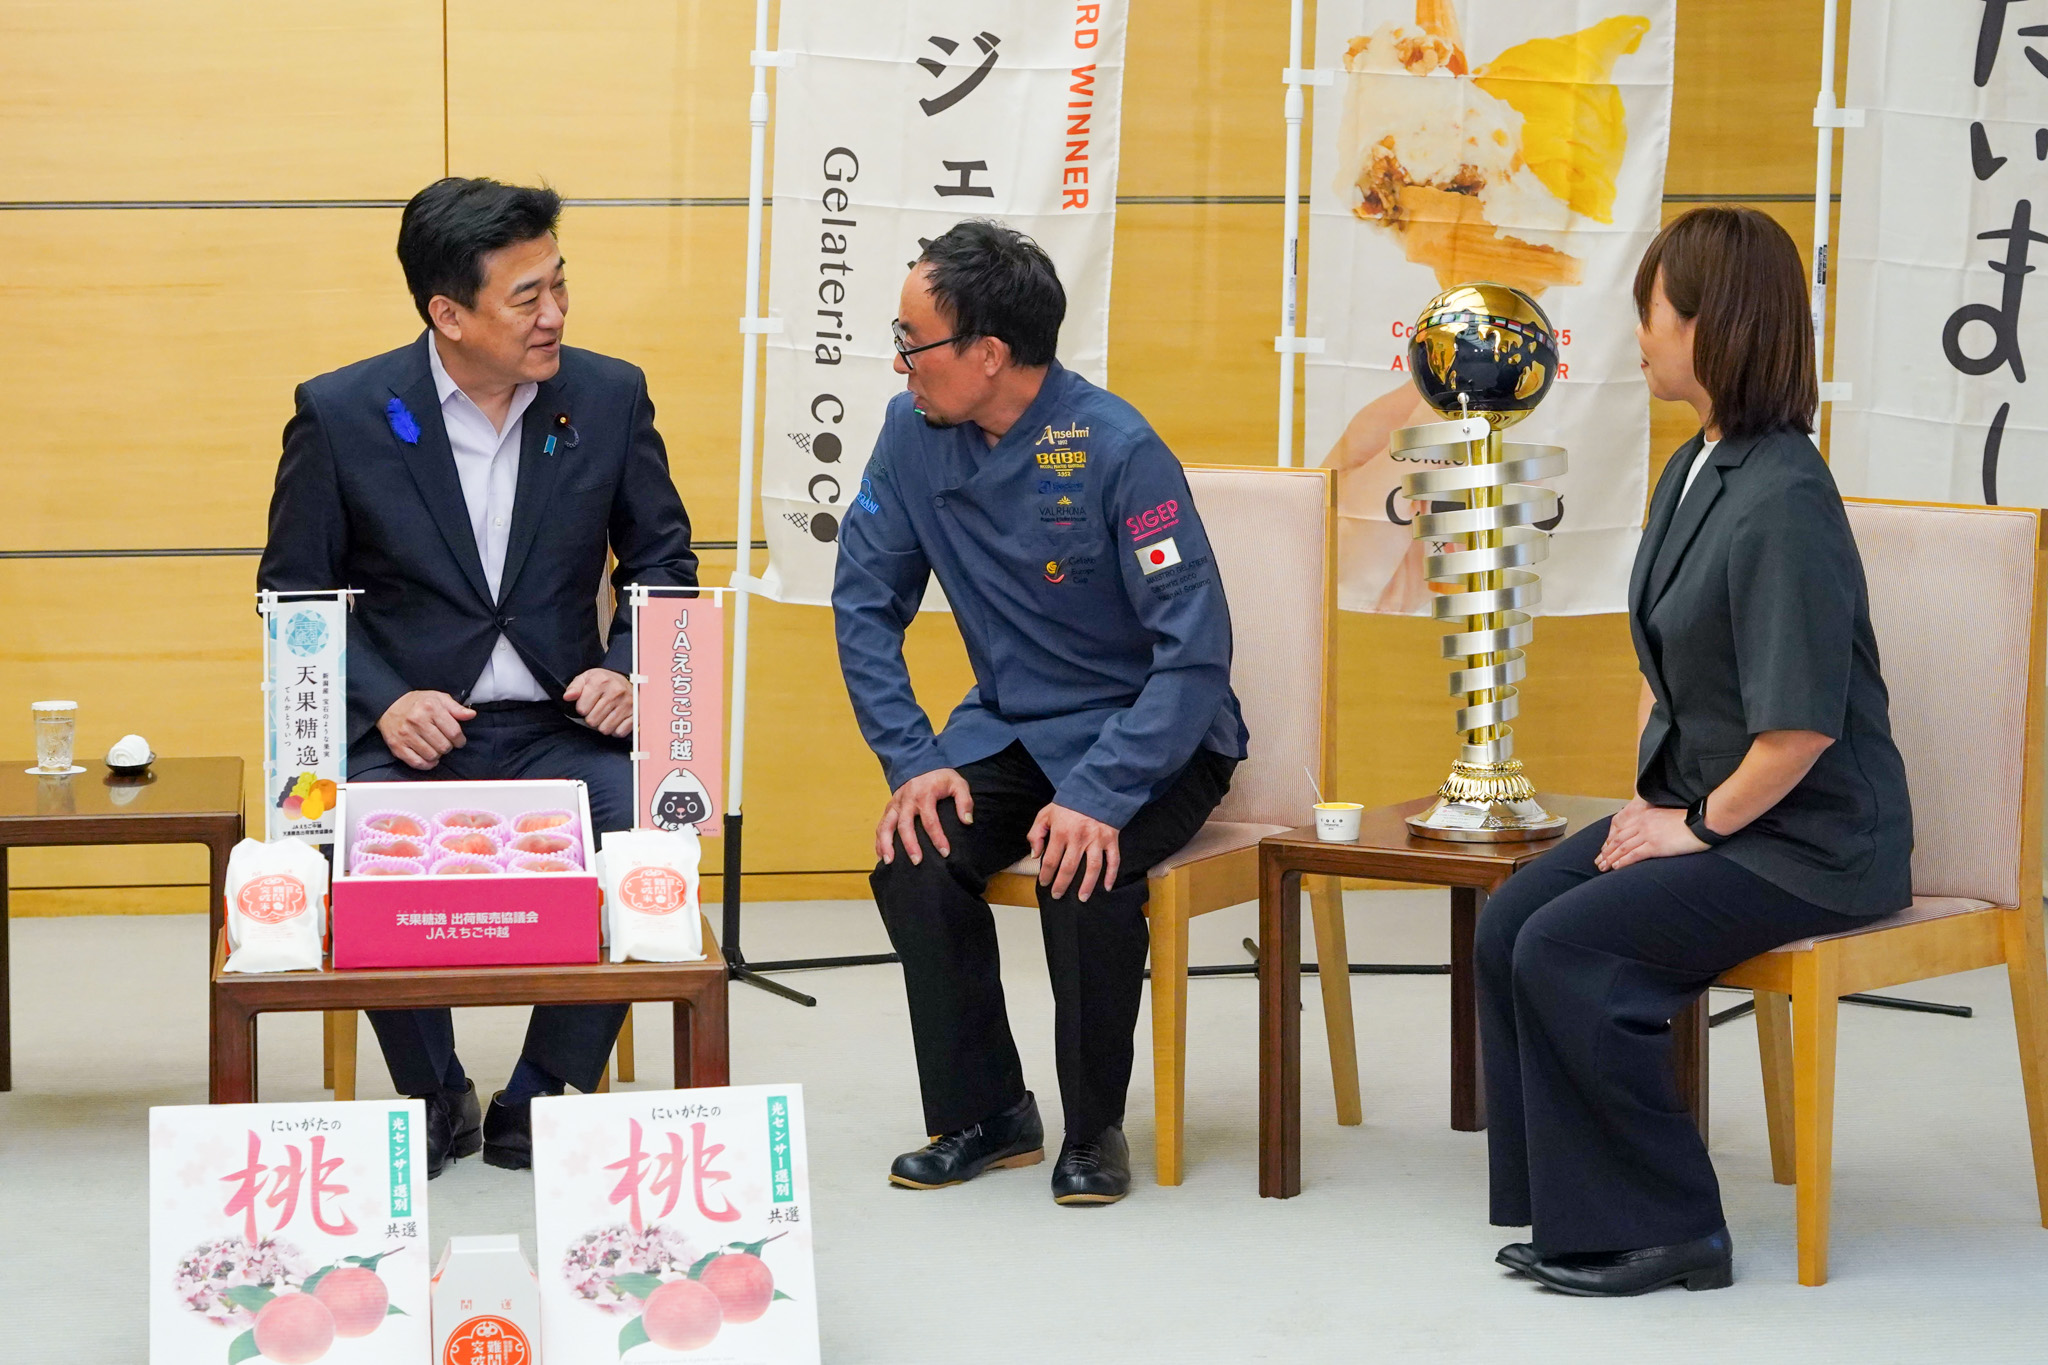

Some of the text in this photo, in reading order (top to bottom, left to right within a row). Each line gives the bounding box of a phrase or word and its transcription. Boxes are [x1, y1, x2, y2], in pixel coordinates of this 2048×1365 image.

[1062, 0, 1100, 210] RD WINNER
[815, 146, 860, 366] Gelateria
[1035, 422, 1090, 446] Anselmi
[1036, 451, 1087, 465] BABBI
[1039, 507, 1087, 516] VALRHONA
[1126, 500, 1178, 535] SIGEP
[670, 609, 693, 762] JAえちご中越
[294, 665, 319, 767] 天果糖逸
[396, 910, 539, 926] 天果糖逸 出荷販売協議会
[426, 926, 510, 940] JAえちご中越
[271, 1117, 341, 1132] にいがたの
[653, 1104, 721, 1120] にいがたの
[771, 1101, 790, 1196] 光センサー選別
[391, 1117, 408, 1212] 光センサー選別
[603, 1117, 742, 1233] 桃
[218, 1129, 358, 1243] 桃
[384, 1221, 418, 1238] 共選
[767, 1206, 800, 1224] 共選
